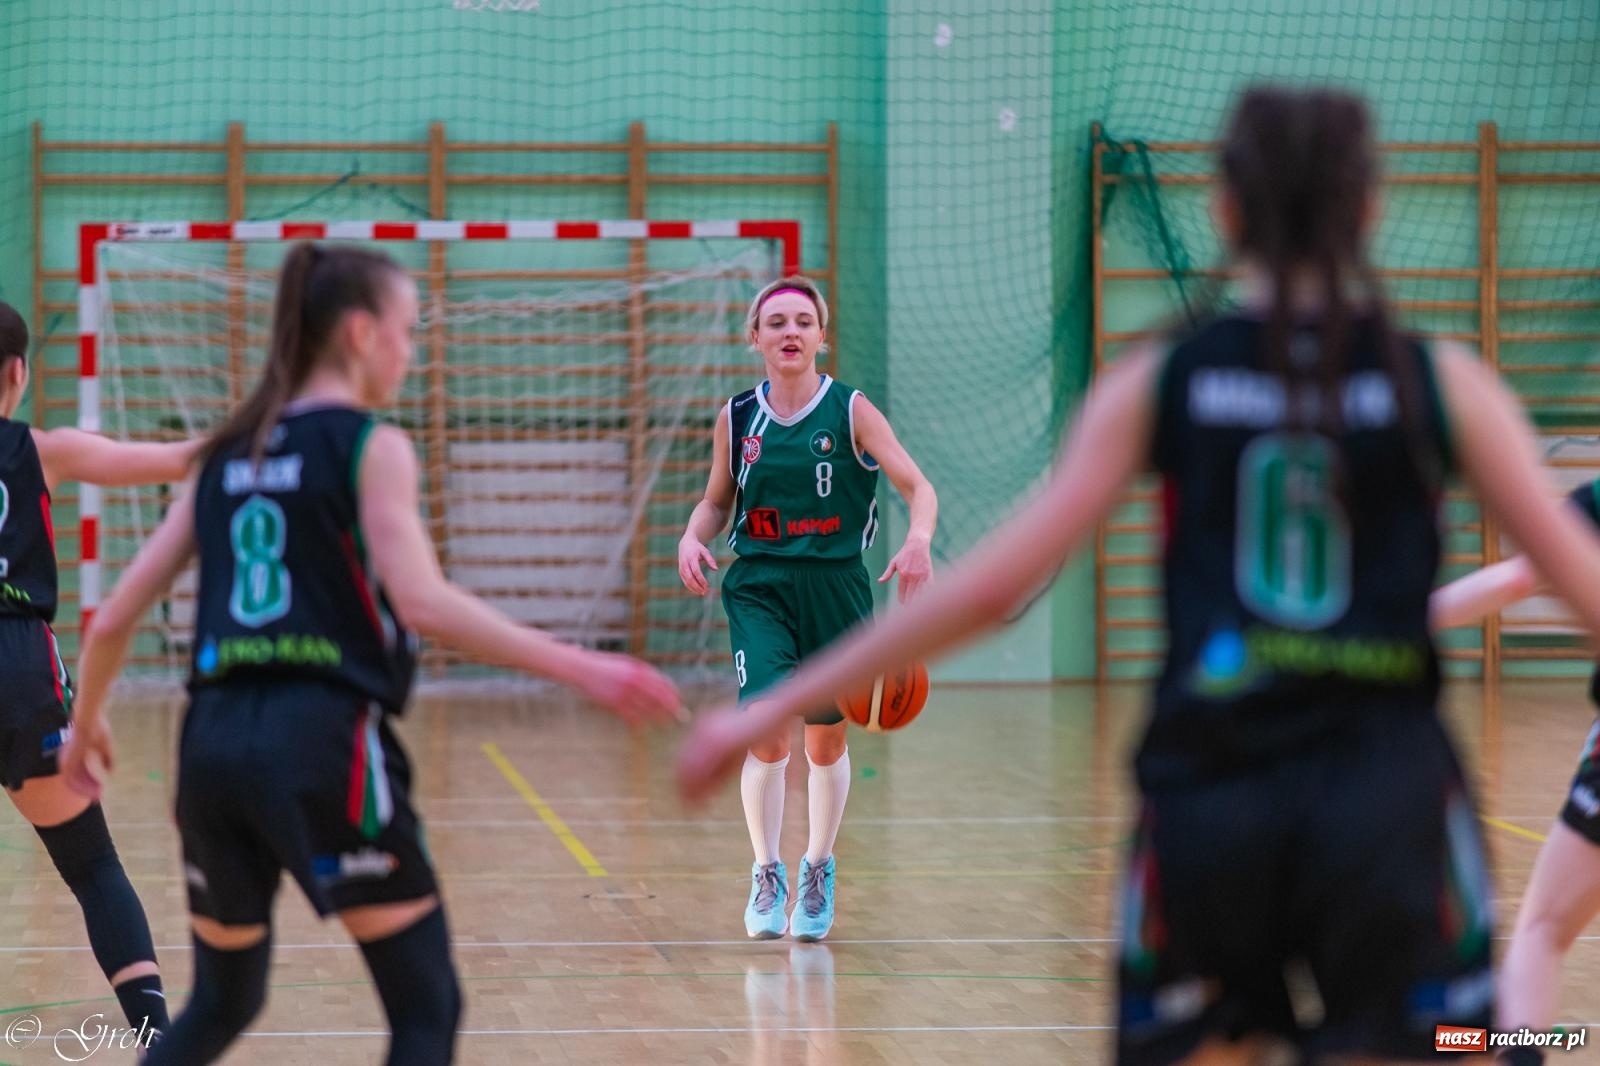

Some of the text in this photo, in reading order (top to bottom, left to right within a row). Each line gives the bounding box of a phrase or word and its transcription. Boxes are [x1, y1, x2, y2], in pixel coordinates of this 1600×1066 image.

[815, 461, 833, 498] 8
[748, 511, 777, 537] K
[1234, 434, 1353, 631] 6
[229, 494, 292, 628] 8
[735, 649, 747, 688] 8
